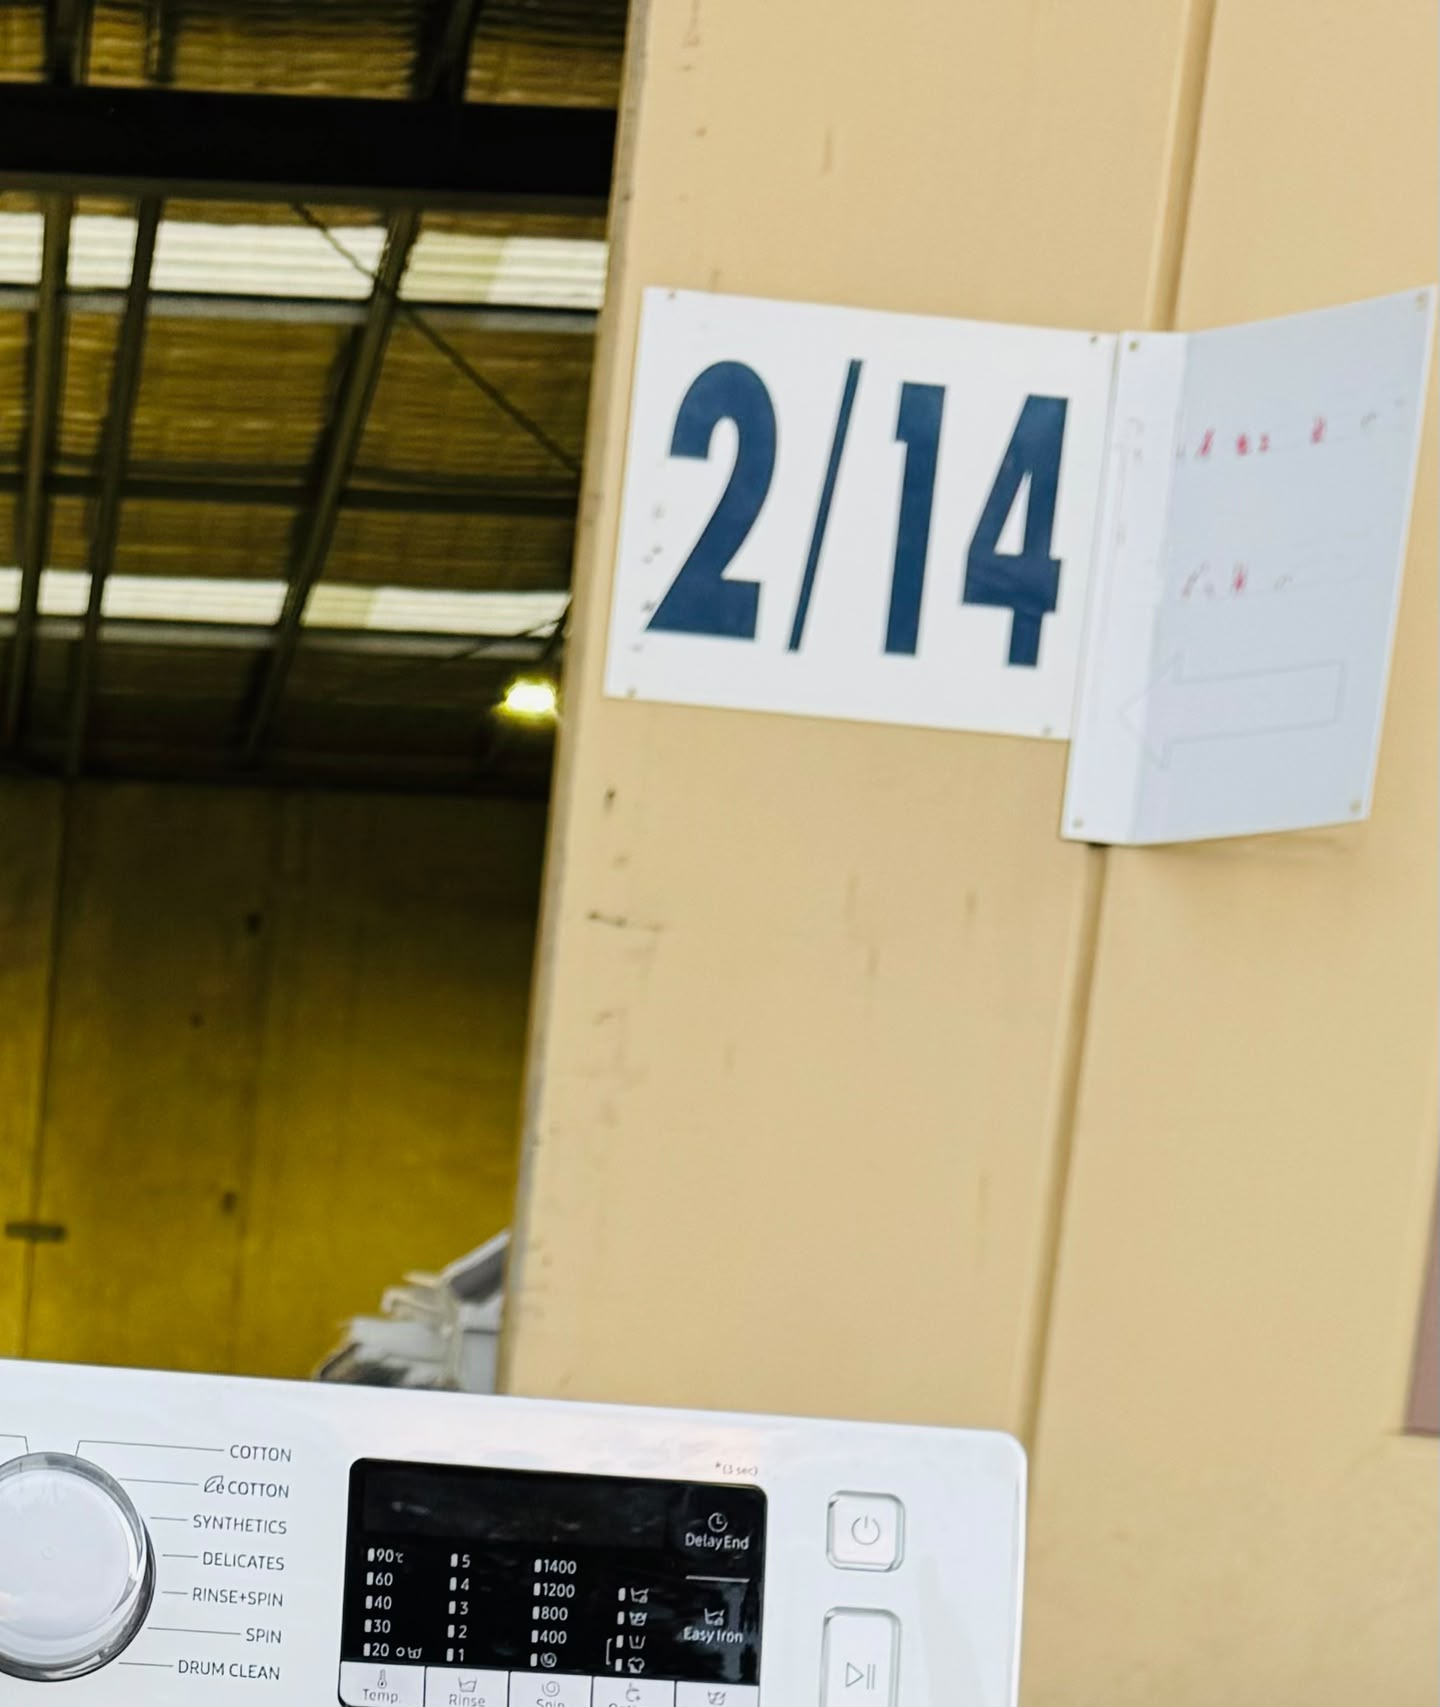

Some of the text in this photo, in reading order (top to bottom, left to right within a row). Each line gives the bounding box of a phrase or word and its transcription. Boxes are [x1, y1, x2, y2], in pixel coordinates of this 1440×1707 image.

[645, 358, 1069, 668] 2/14
[230, 1444, 291, 1462] COTTON
[228, 1480, 289, 1498] COTTON
[193, 1514, 287, 1535] SYNTHETICS
[203, 1551, 285, 1571] DELICATES
[462, 1554, 471, 1568] 5
[544, 1559, 577, 1574] 1400
[375, 1572, 393, 1586] 60
[460, 1577, 470, 1591] 4
[192, 1587, 283, 1607] RINSE+SPIN
[543, 1583, 575, 1598] 1200
[374, 1596, 392, 1610] 40
[460, 1601, 469, 1615] 3
[540, 1606, 568, 1621] 800
[373, 1619, 391, 1633] 30
[458, 1625, 468, 1638] 2
[246, 1628, 281, 1644] SPIN
[540, 1630, 567, 1645] 400
[684, 1627, 743, 1643] Easy Iron
[372, 1643, 389, 1657] 20
[458, 1648, 464, 1661] 1
[178, 1660, 280, 1680] DRUM CLEAN
[449, 1693, 486, 1707] Rinse
